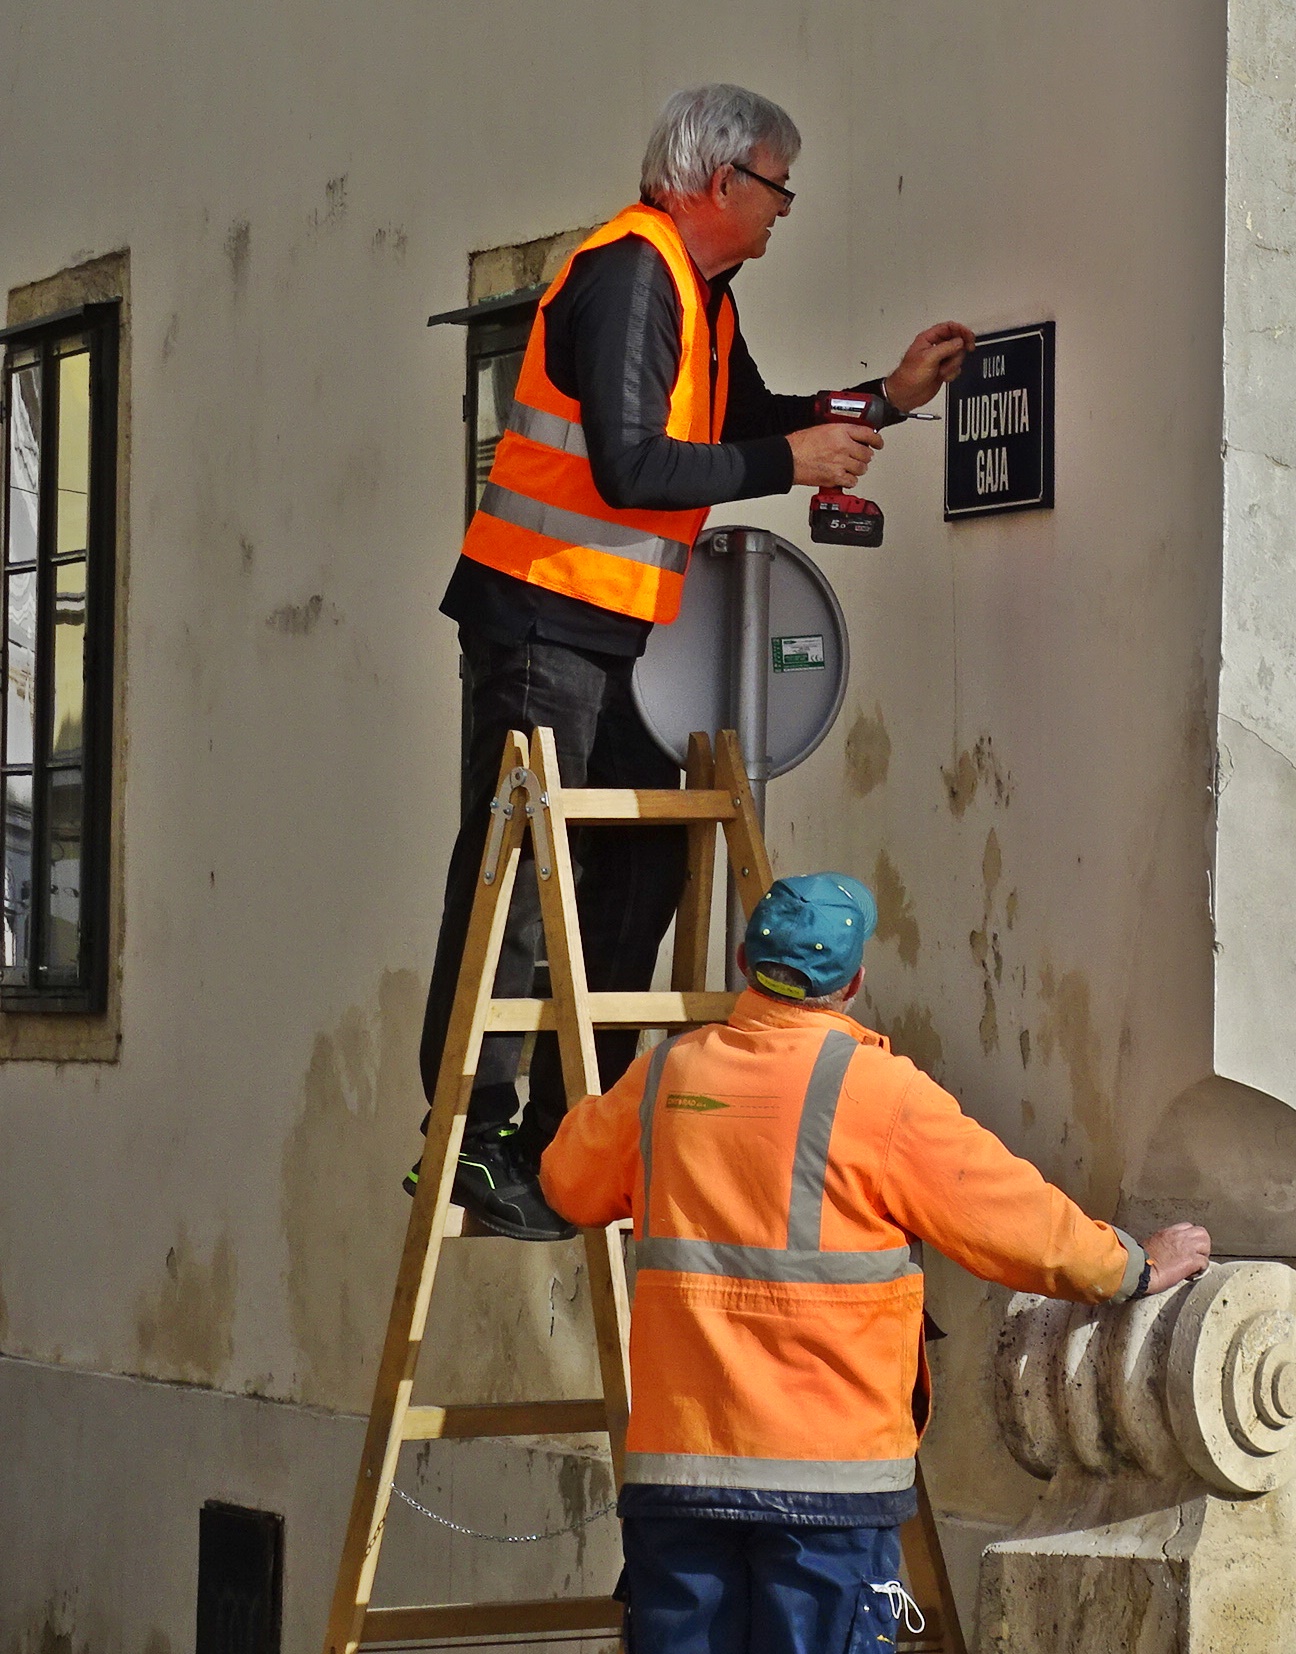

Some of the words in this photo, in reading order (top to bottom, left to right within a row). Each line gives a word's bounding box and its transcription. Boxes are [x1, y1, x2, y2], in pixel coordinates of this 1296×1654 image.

[983, 355, 1006, 379] ULICA
[958, 388, 1030, 443] LJUDEVITA
[976, 447, 1009, 496] GAJA
